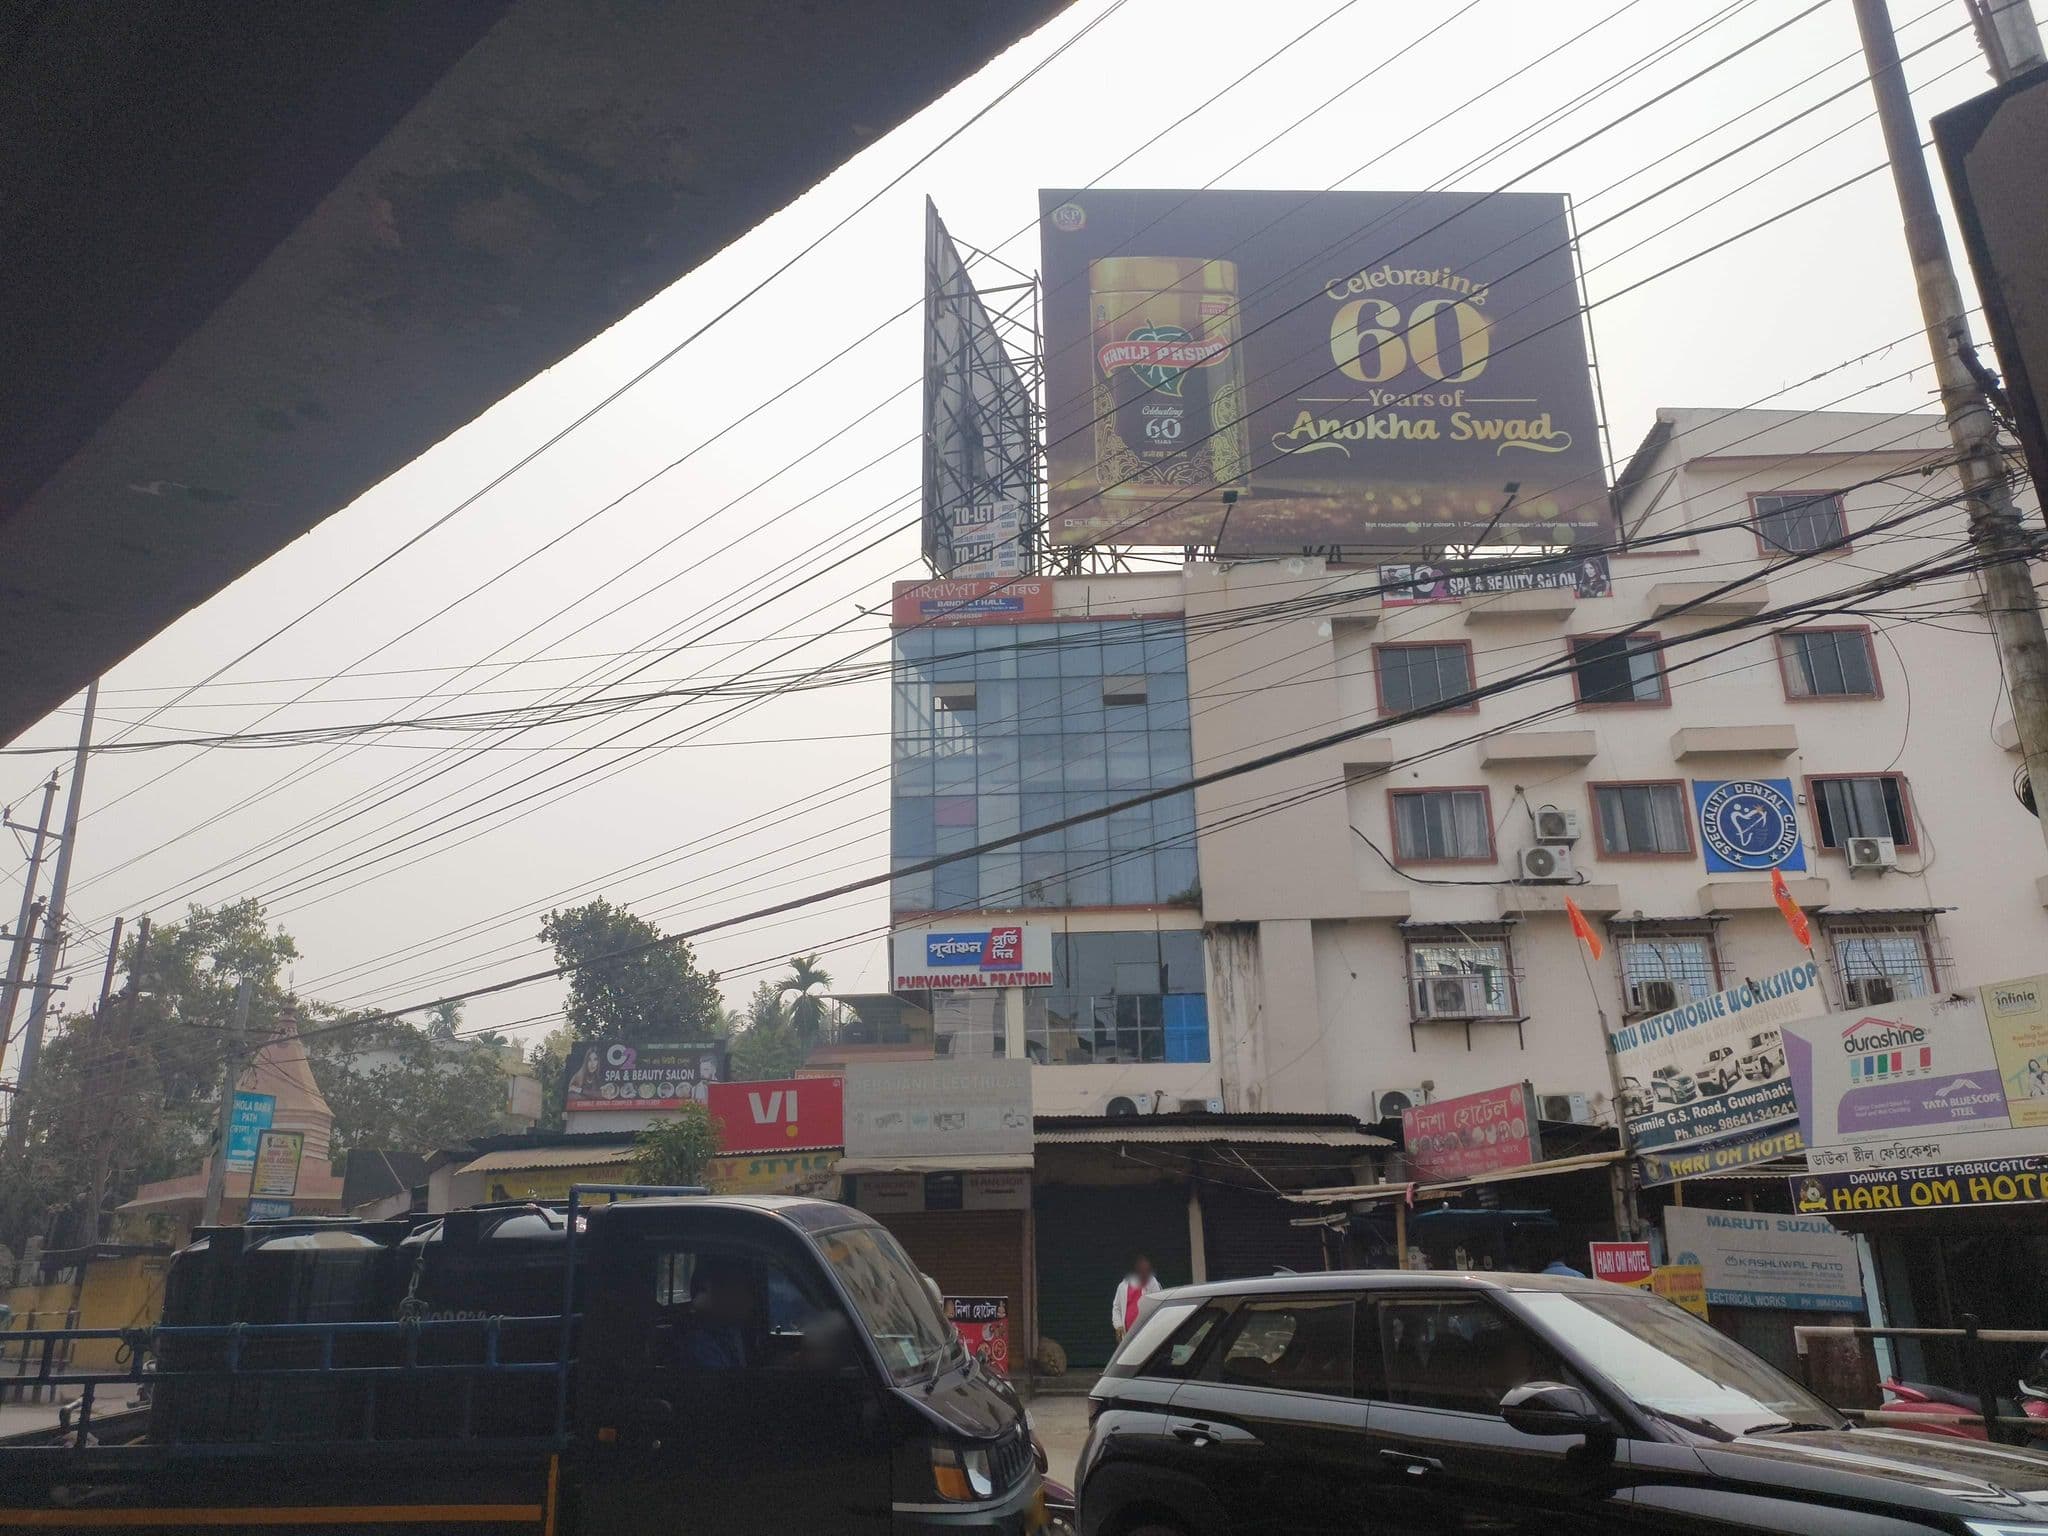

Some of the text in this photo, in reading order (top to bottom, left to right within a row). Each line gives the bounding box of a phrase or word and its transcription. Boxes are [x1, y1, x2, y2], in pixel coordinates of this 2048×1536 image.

[1324, 265, 1490, 305] Celebrating
[1330, 298, 1490, 382] 60
[1368, 388, 1465, 408] Years of
[1145, 417, 1182, 440] 60
[1282, 409, 1560, 443] Anokha Swad
[953, 505, 994, 526] TO-LET
[1450, 570, 1577, 595] SPA & BEAUTY SALON
[1734, 783, 1785, 810] DENTAL
[1705, 789, 1732, 855] SPECIALITY
[1777, 814, 1796, 854] CLINIC
[897, 971, 1052, 990] PURVANCHAL PRATIDIN
[1640, 993, 1726, 1044] AUTOMOBILE
[1726, 961, 1818, 1012] WORKSHOP
[1995, 990, 2036, 1007] infinia
[1844, 1026, 1925, 1054] durashine
[604, 1068, 695, 1081] SPA & BEAUTY SALON
[1628, 1083, 1792, 1135] Sixmile G.S. Road, Guwahati-
[1922, 1092, 2001, 1110] TATA BLUESCOPE
[1950, 1106, 1976, 1118] STEEL
[1415, 1098, 1510, 1133] নিশা হোটেল
[1674, 1128, 1692, 1142] Ph.
[1694, 1124, 1717, 1138] No:-
[1718, 1101, 1797, 1131] 98641-34241
[1669, 1155, 1711, 1178] HARI
[1715, 1149, 1743, 1171] OM
[1749, 1131, 1806, 1160] HOTEL
[1849, 1156, 2047, 1186] DAWKA STEEL FABRICATIO
[1831, 1184, 1903, 1213] HARI
[1909, 1178, 1960, 1207] OM
[1706, 1215, 1838, 1235] MARUTI SUZUK
[1597, 1251, 1650, 1274] HARI OM HOTEL
[1810, 1260, 1843, 1272] AUTO
[954, 1299, 997, 1319] নিশা হোটেল
[1755, 1294, 1787, 1308] WORKS
